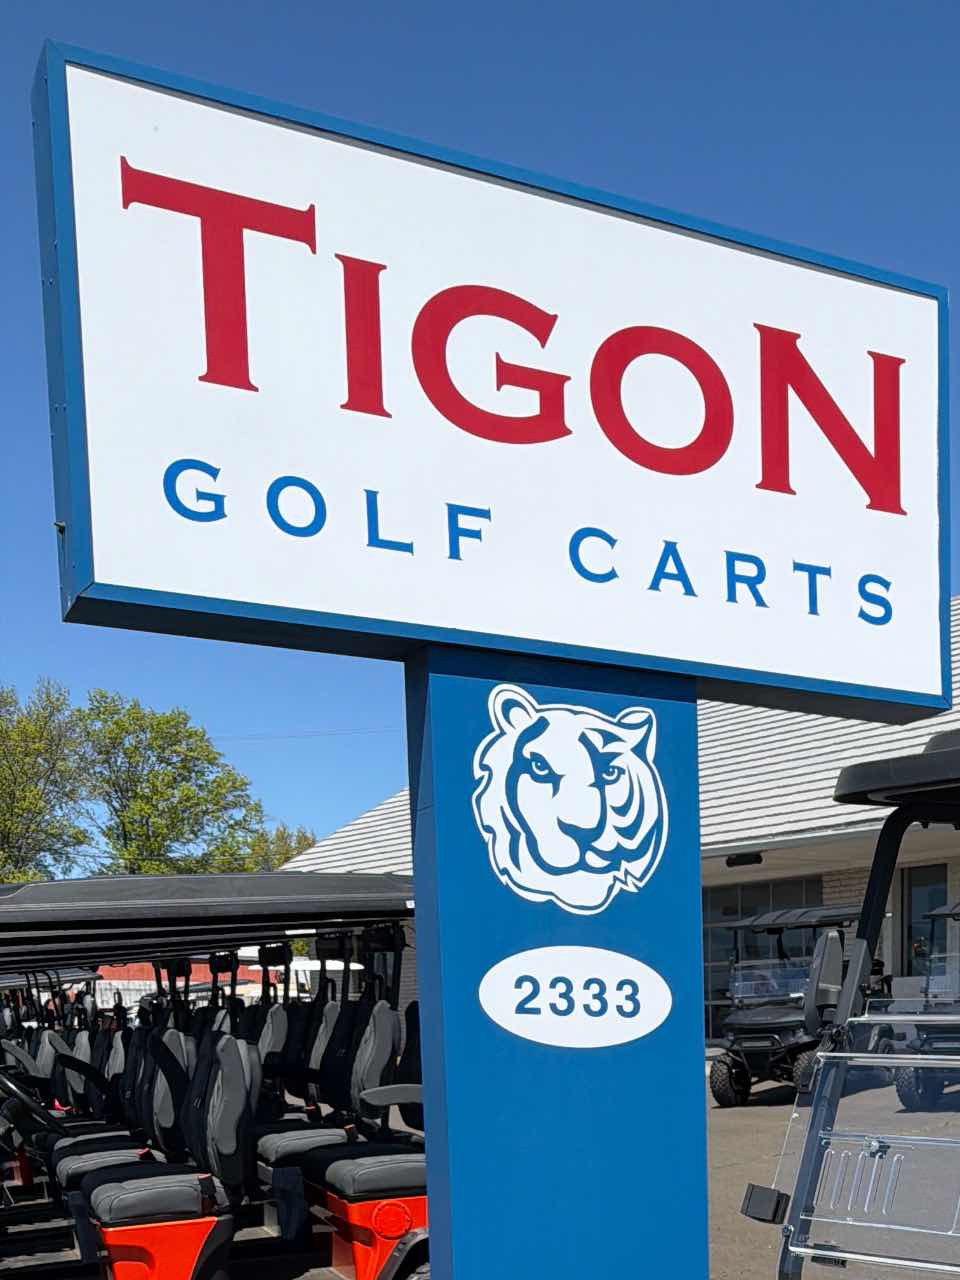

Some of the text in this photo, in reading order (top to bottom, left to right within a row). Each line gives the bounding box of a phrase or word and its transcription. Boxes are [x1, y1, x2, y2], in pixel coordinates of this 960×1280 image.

[120, 156, 907, 516] TIGON
[163, 458, 893, 626] GOLF CARTS
[514, 974, 641, 1018] 2333
